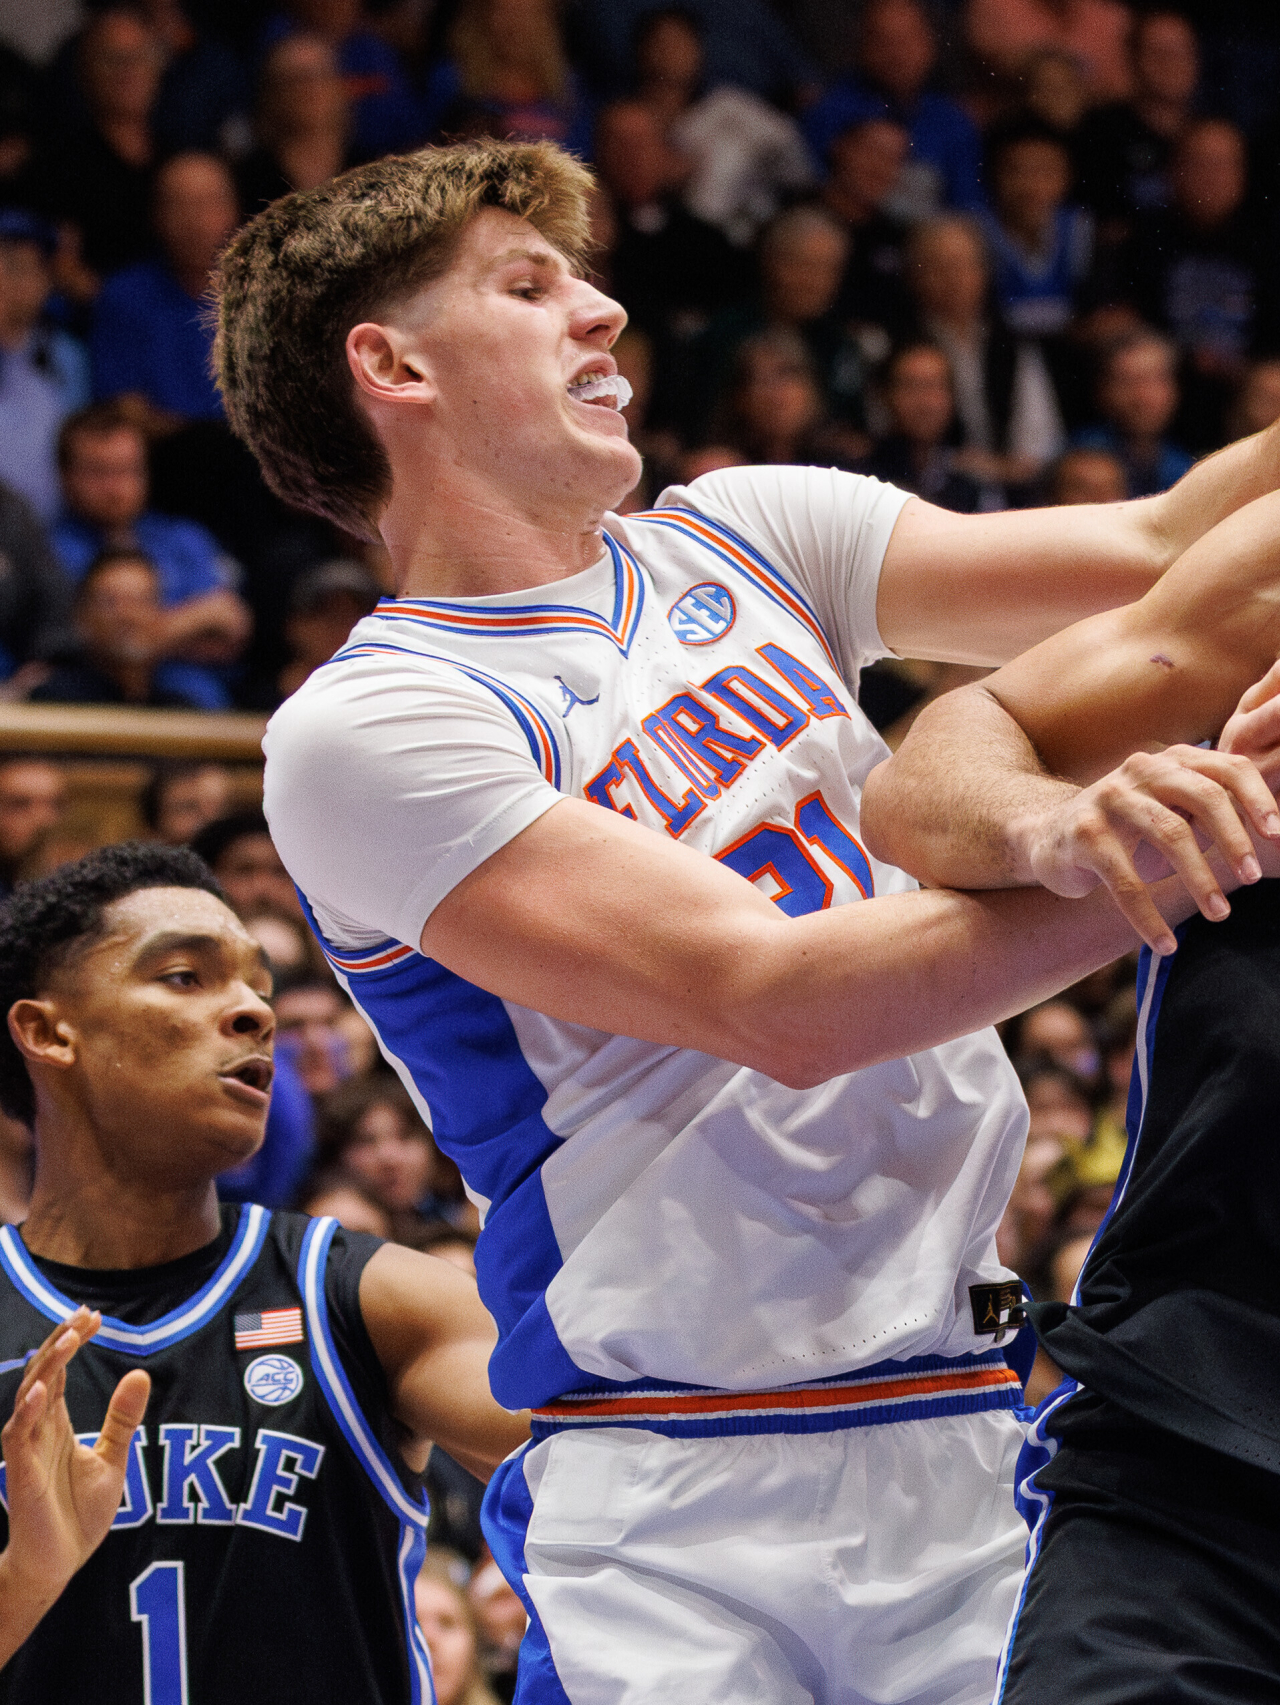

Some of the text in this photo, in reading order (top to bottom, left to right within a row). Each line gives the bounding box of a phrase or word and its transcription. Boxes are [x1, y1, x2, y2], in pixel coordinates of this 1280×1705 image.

[669, 586, 732, 641] SEC
[582, 641, 852, 840] FLORDA
[0, 1423, 326, 1543] UKE
[129, 1560, 189, 1705] 1
